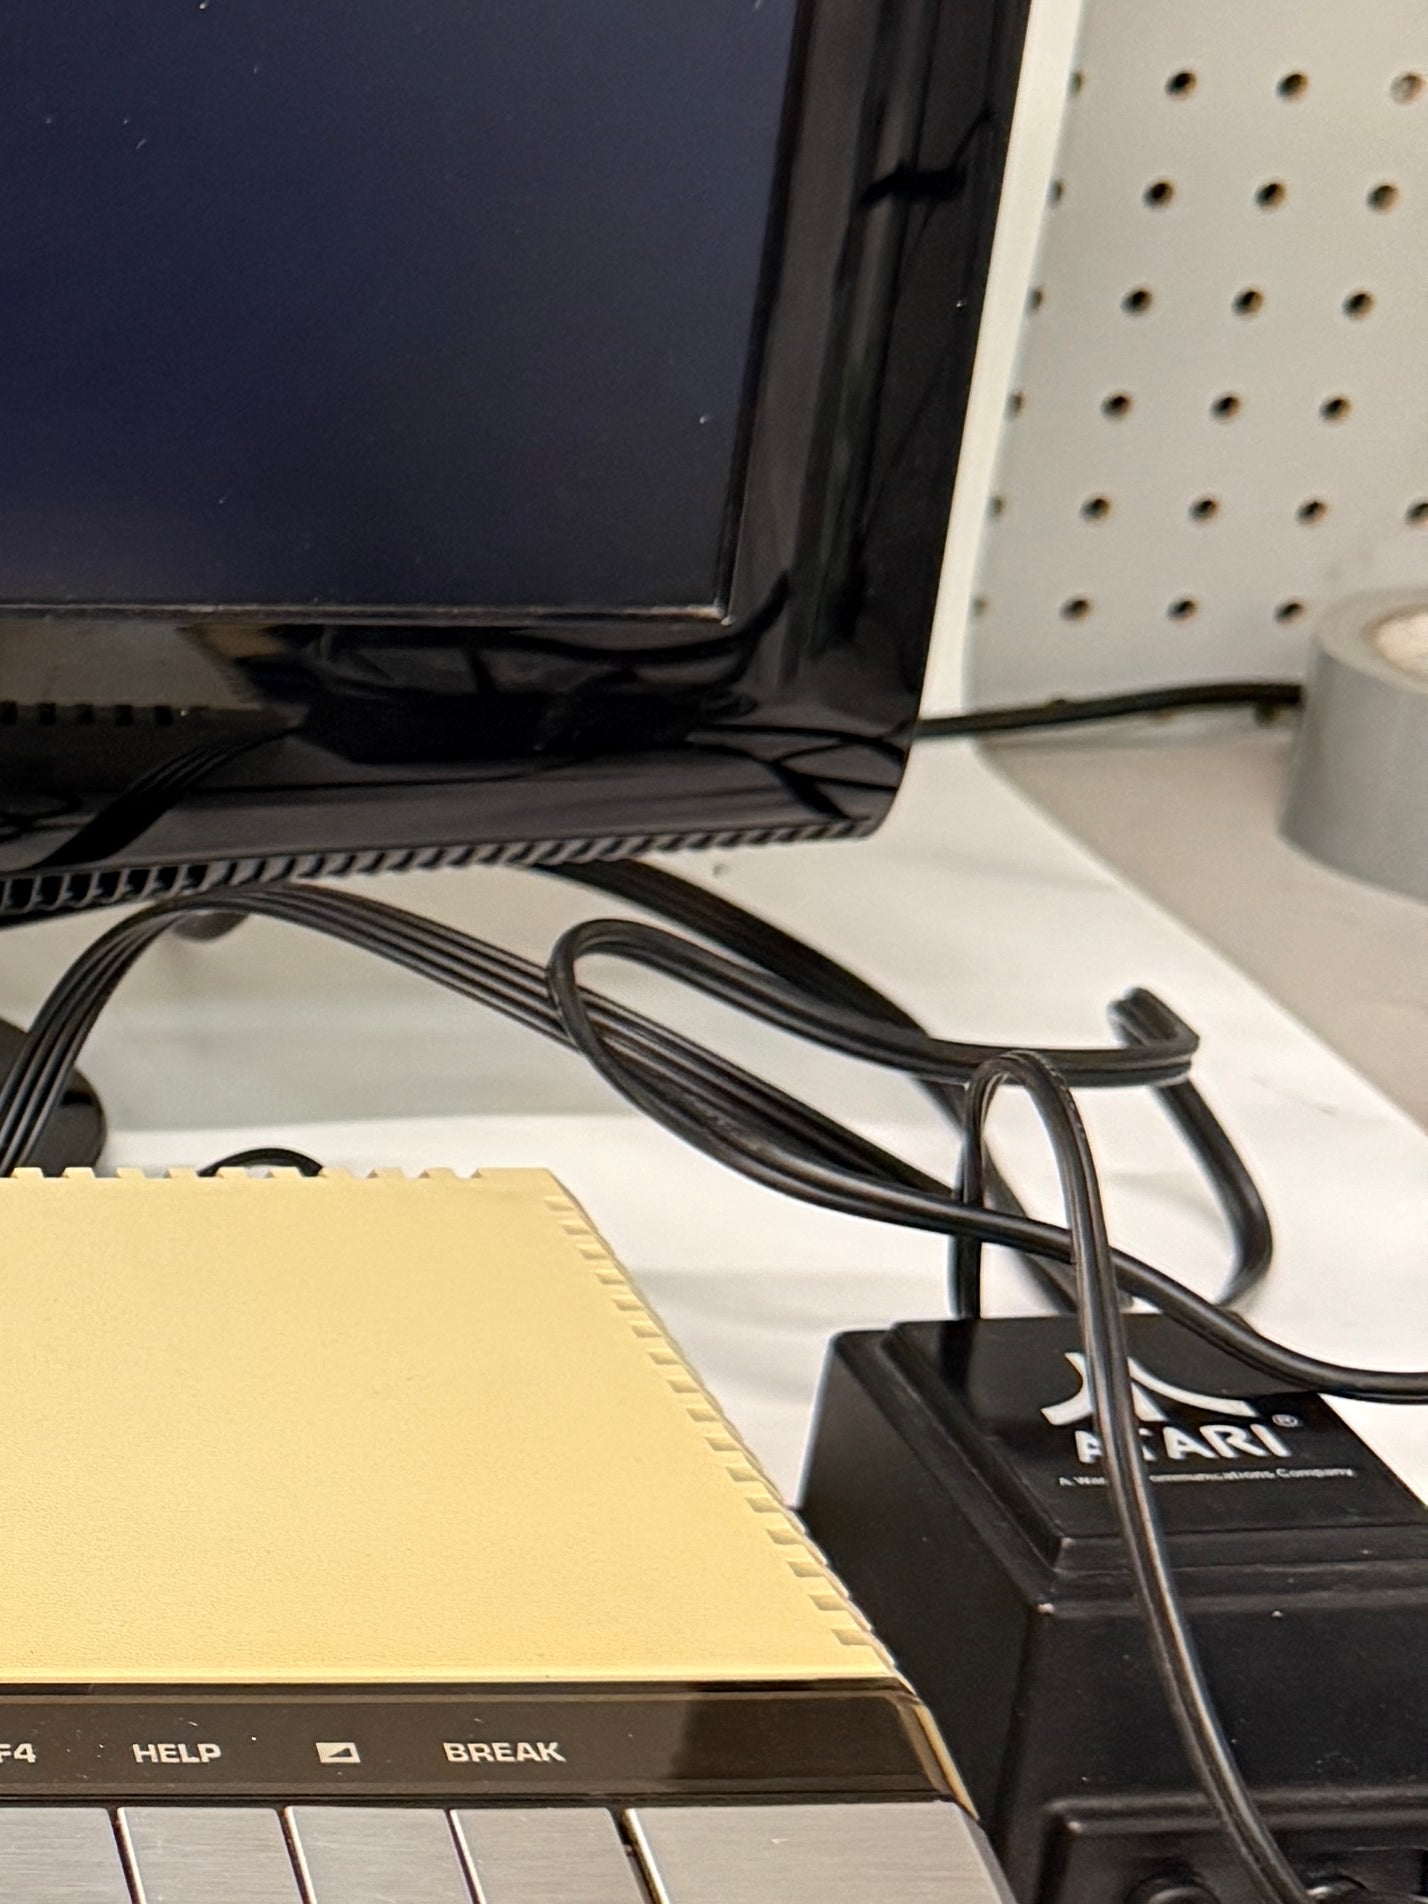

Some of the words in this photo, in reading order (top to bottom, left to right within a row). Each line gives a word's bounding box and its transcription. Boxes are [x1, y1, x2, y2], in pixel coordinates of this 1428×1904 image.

[1075, 1423, 1292, 1464] AARI
[132, 1743, 223, 1765] HELP
[442, 1742, 567, 1764] BREAK
